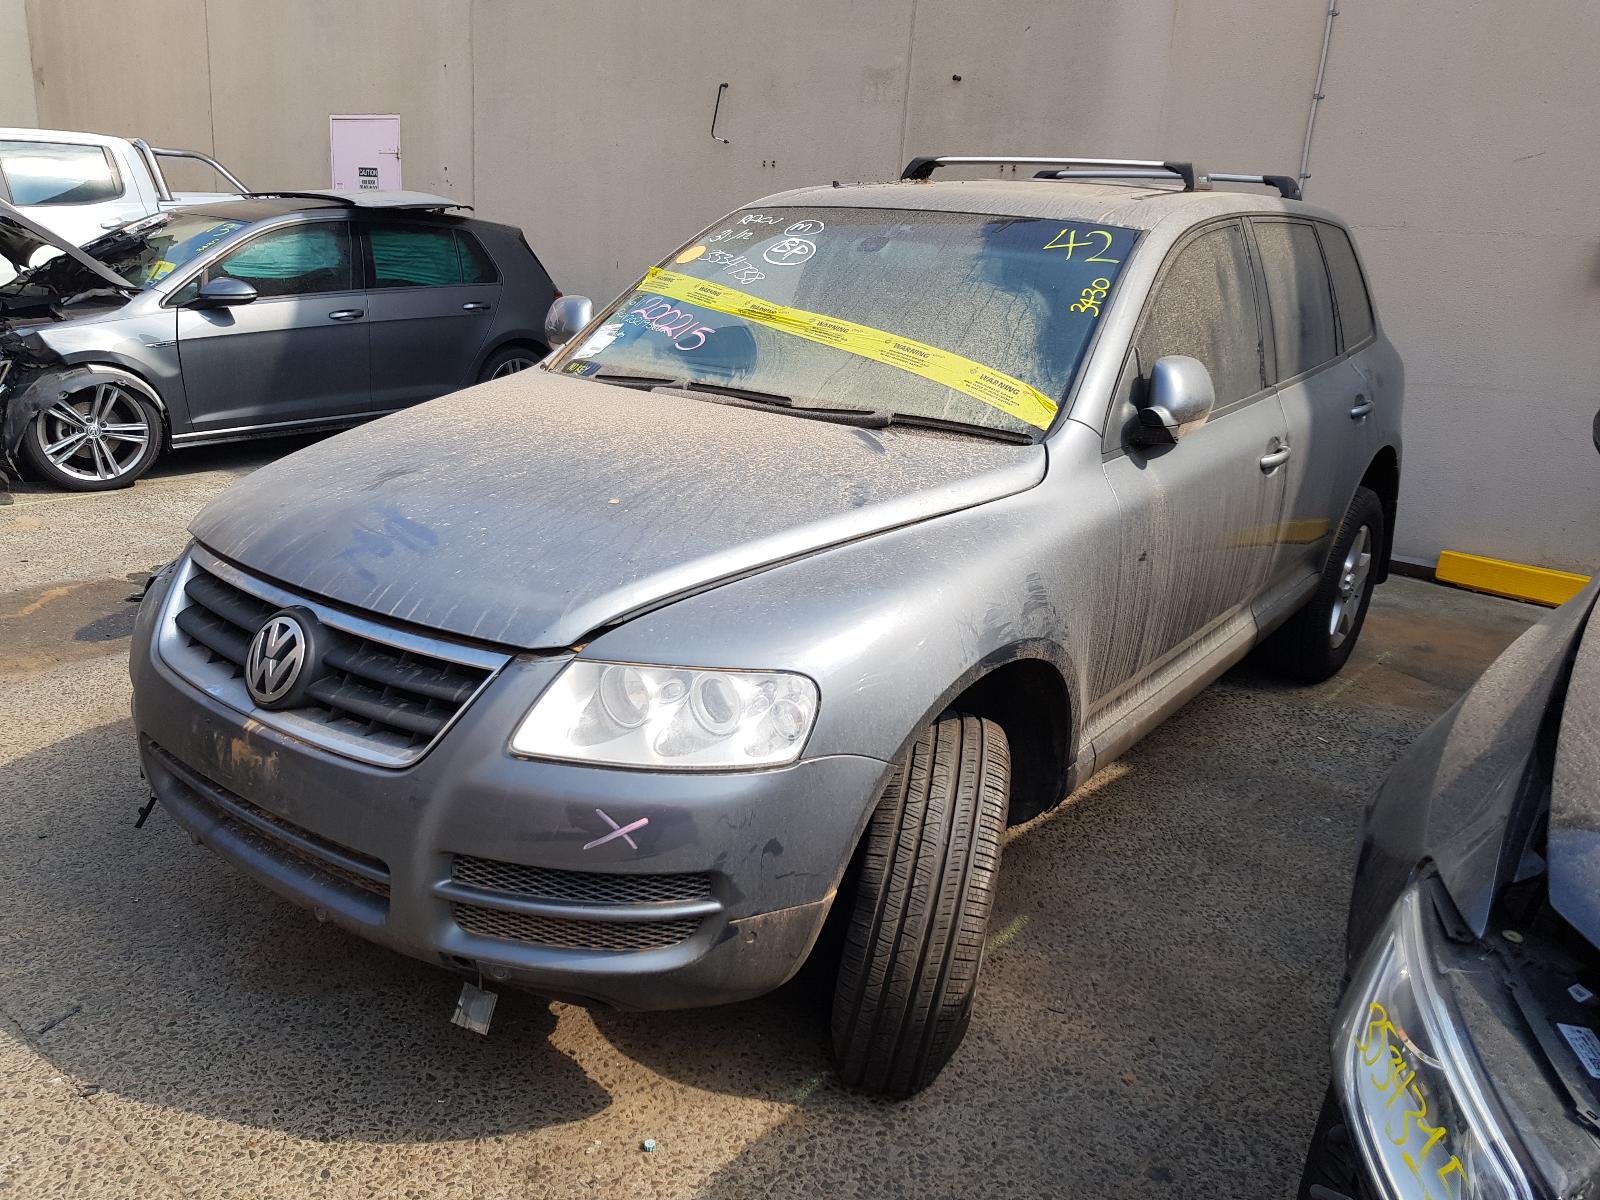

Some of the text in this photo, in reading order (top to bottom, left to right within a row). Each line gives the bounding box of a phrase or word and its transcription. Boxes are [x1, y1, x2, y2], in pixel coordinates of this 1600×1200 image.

[1042, 229, 1120, 264] 42
[1070, 277, 1111, 318] 3430
[893, 342, 931, 359] WARNING
[979, 373, 1021, 396] WARNING
